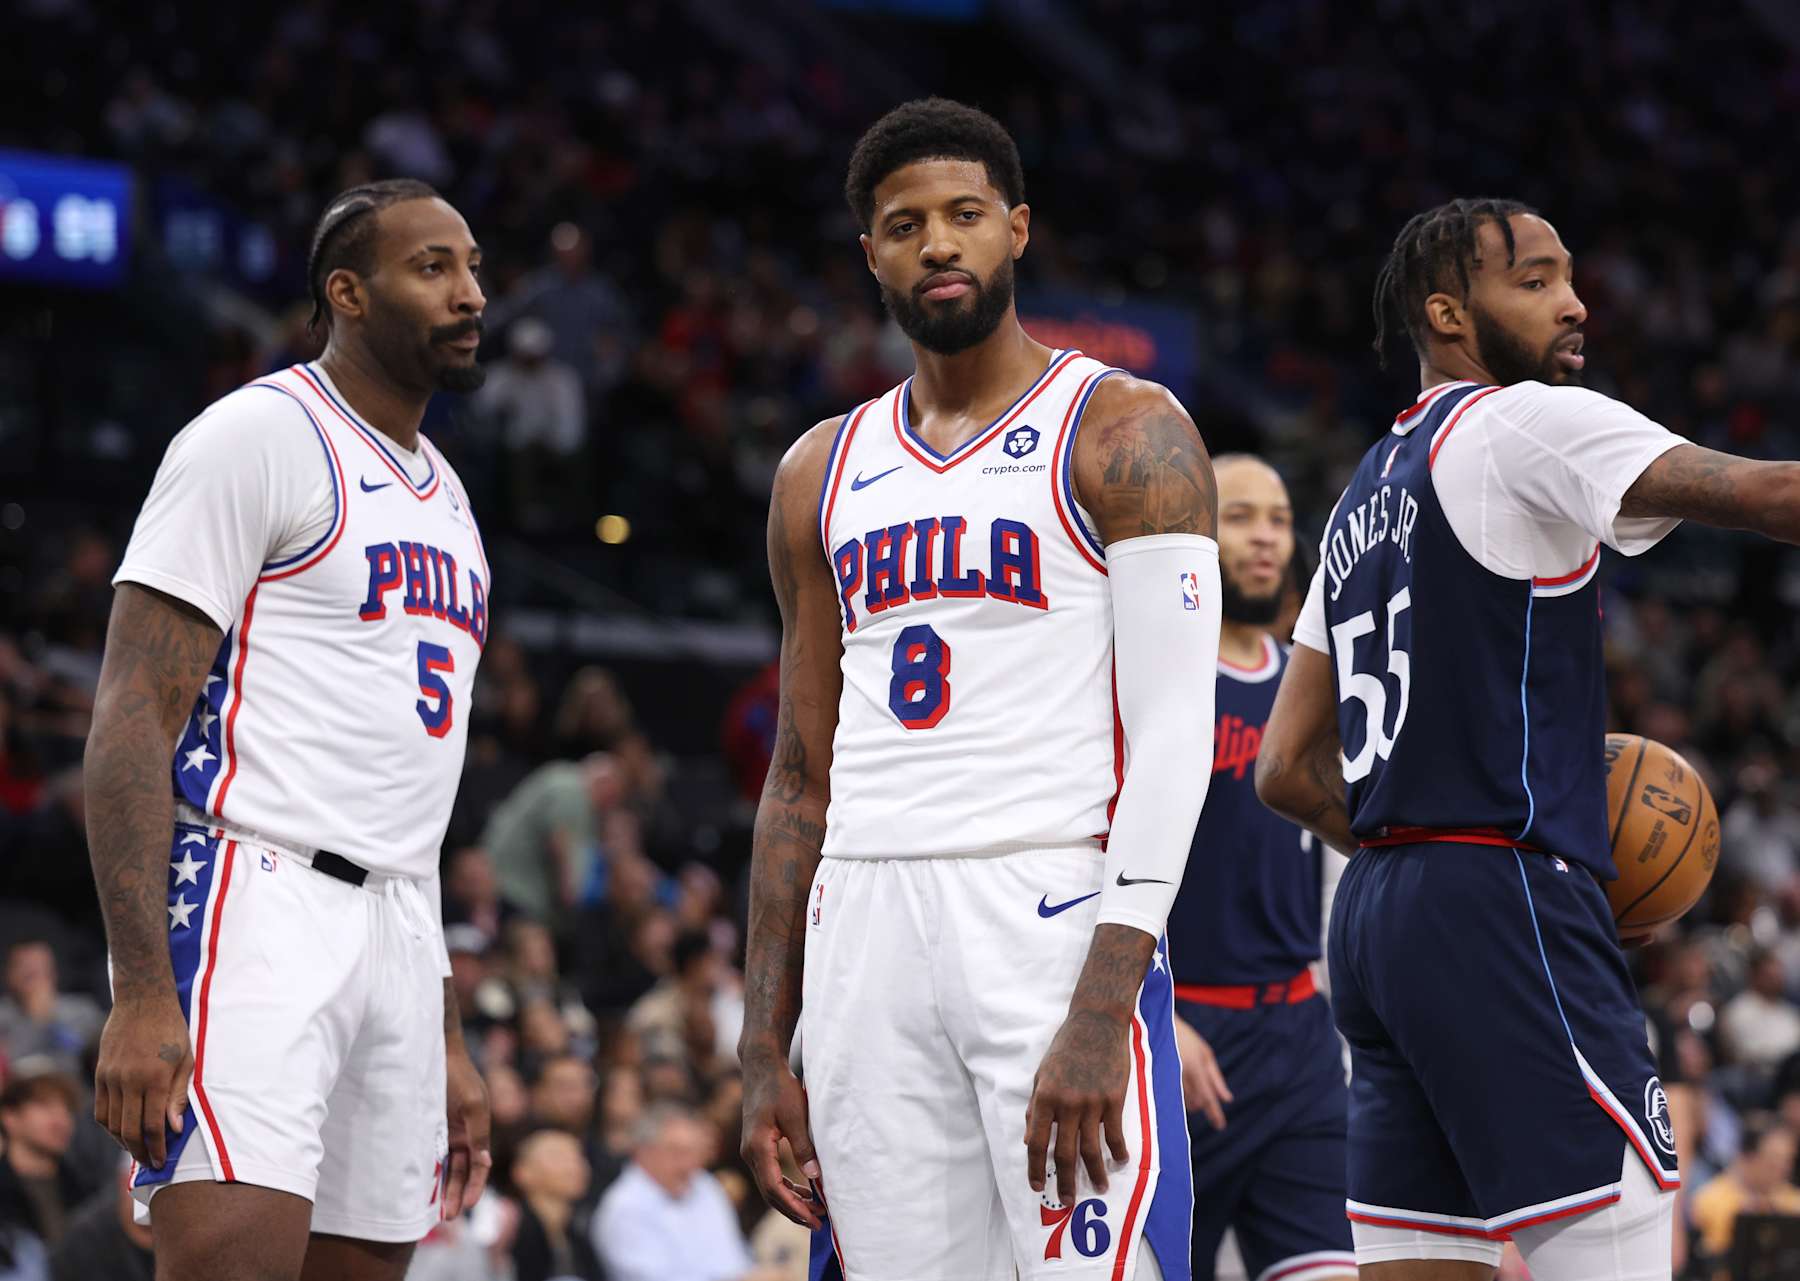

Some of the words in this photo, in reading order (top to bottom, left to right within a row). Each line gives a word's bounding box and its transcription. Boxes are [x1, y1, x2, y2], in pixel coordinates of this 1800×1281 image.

[982, 465, 1046, 475] crypto.com
[833, 515, 1049, 634] PHILA
[1326, 484, 1392, 601] JONES
[415, 639, 455, 739] 5
[888, 623, 951, 731] 8
[1330, 586, 1411, 784] 55
[1040, 1198, 1111, 1261] 76
